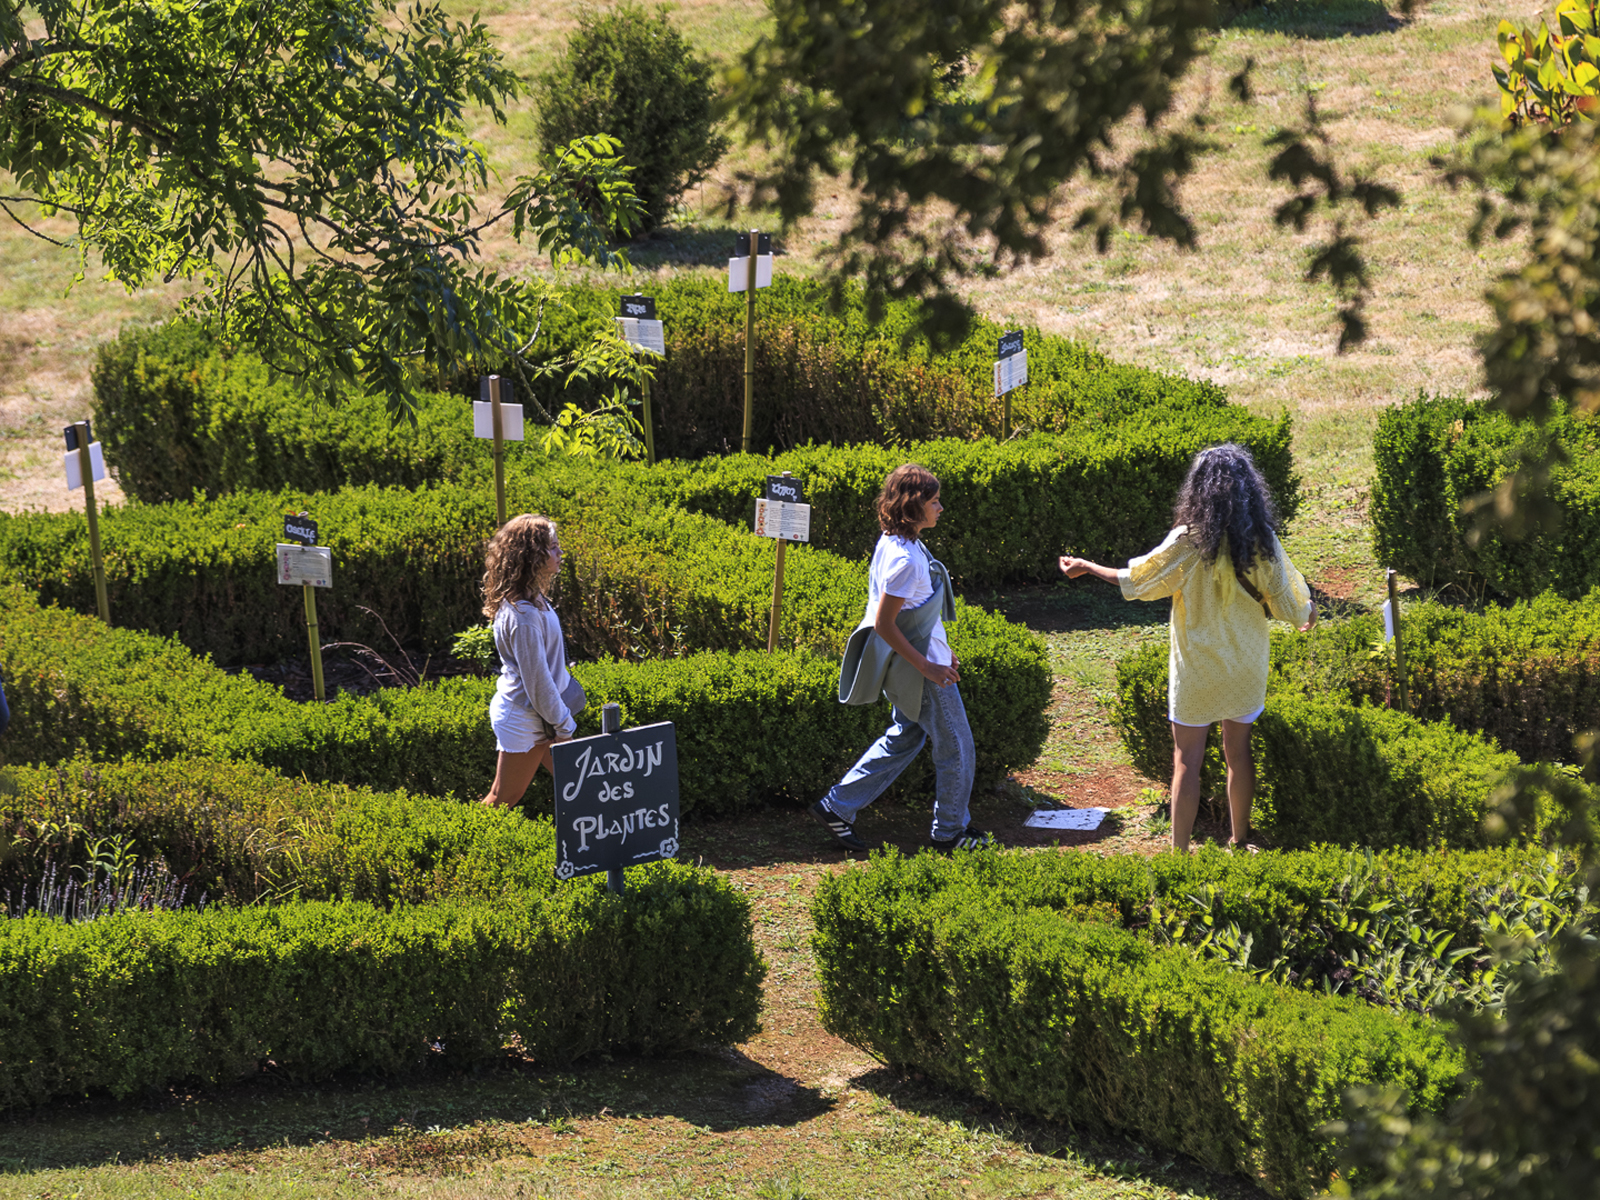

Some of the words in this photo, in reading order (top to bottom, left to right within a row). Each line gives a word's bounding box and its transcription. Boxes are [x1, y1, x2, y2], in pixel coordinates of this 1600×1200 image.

[562, 741, 664, 801] JARDIN
[598, 781, 635, 802] des
[572, 803, 670, 853] PLANTES
